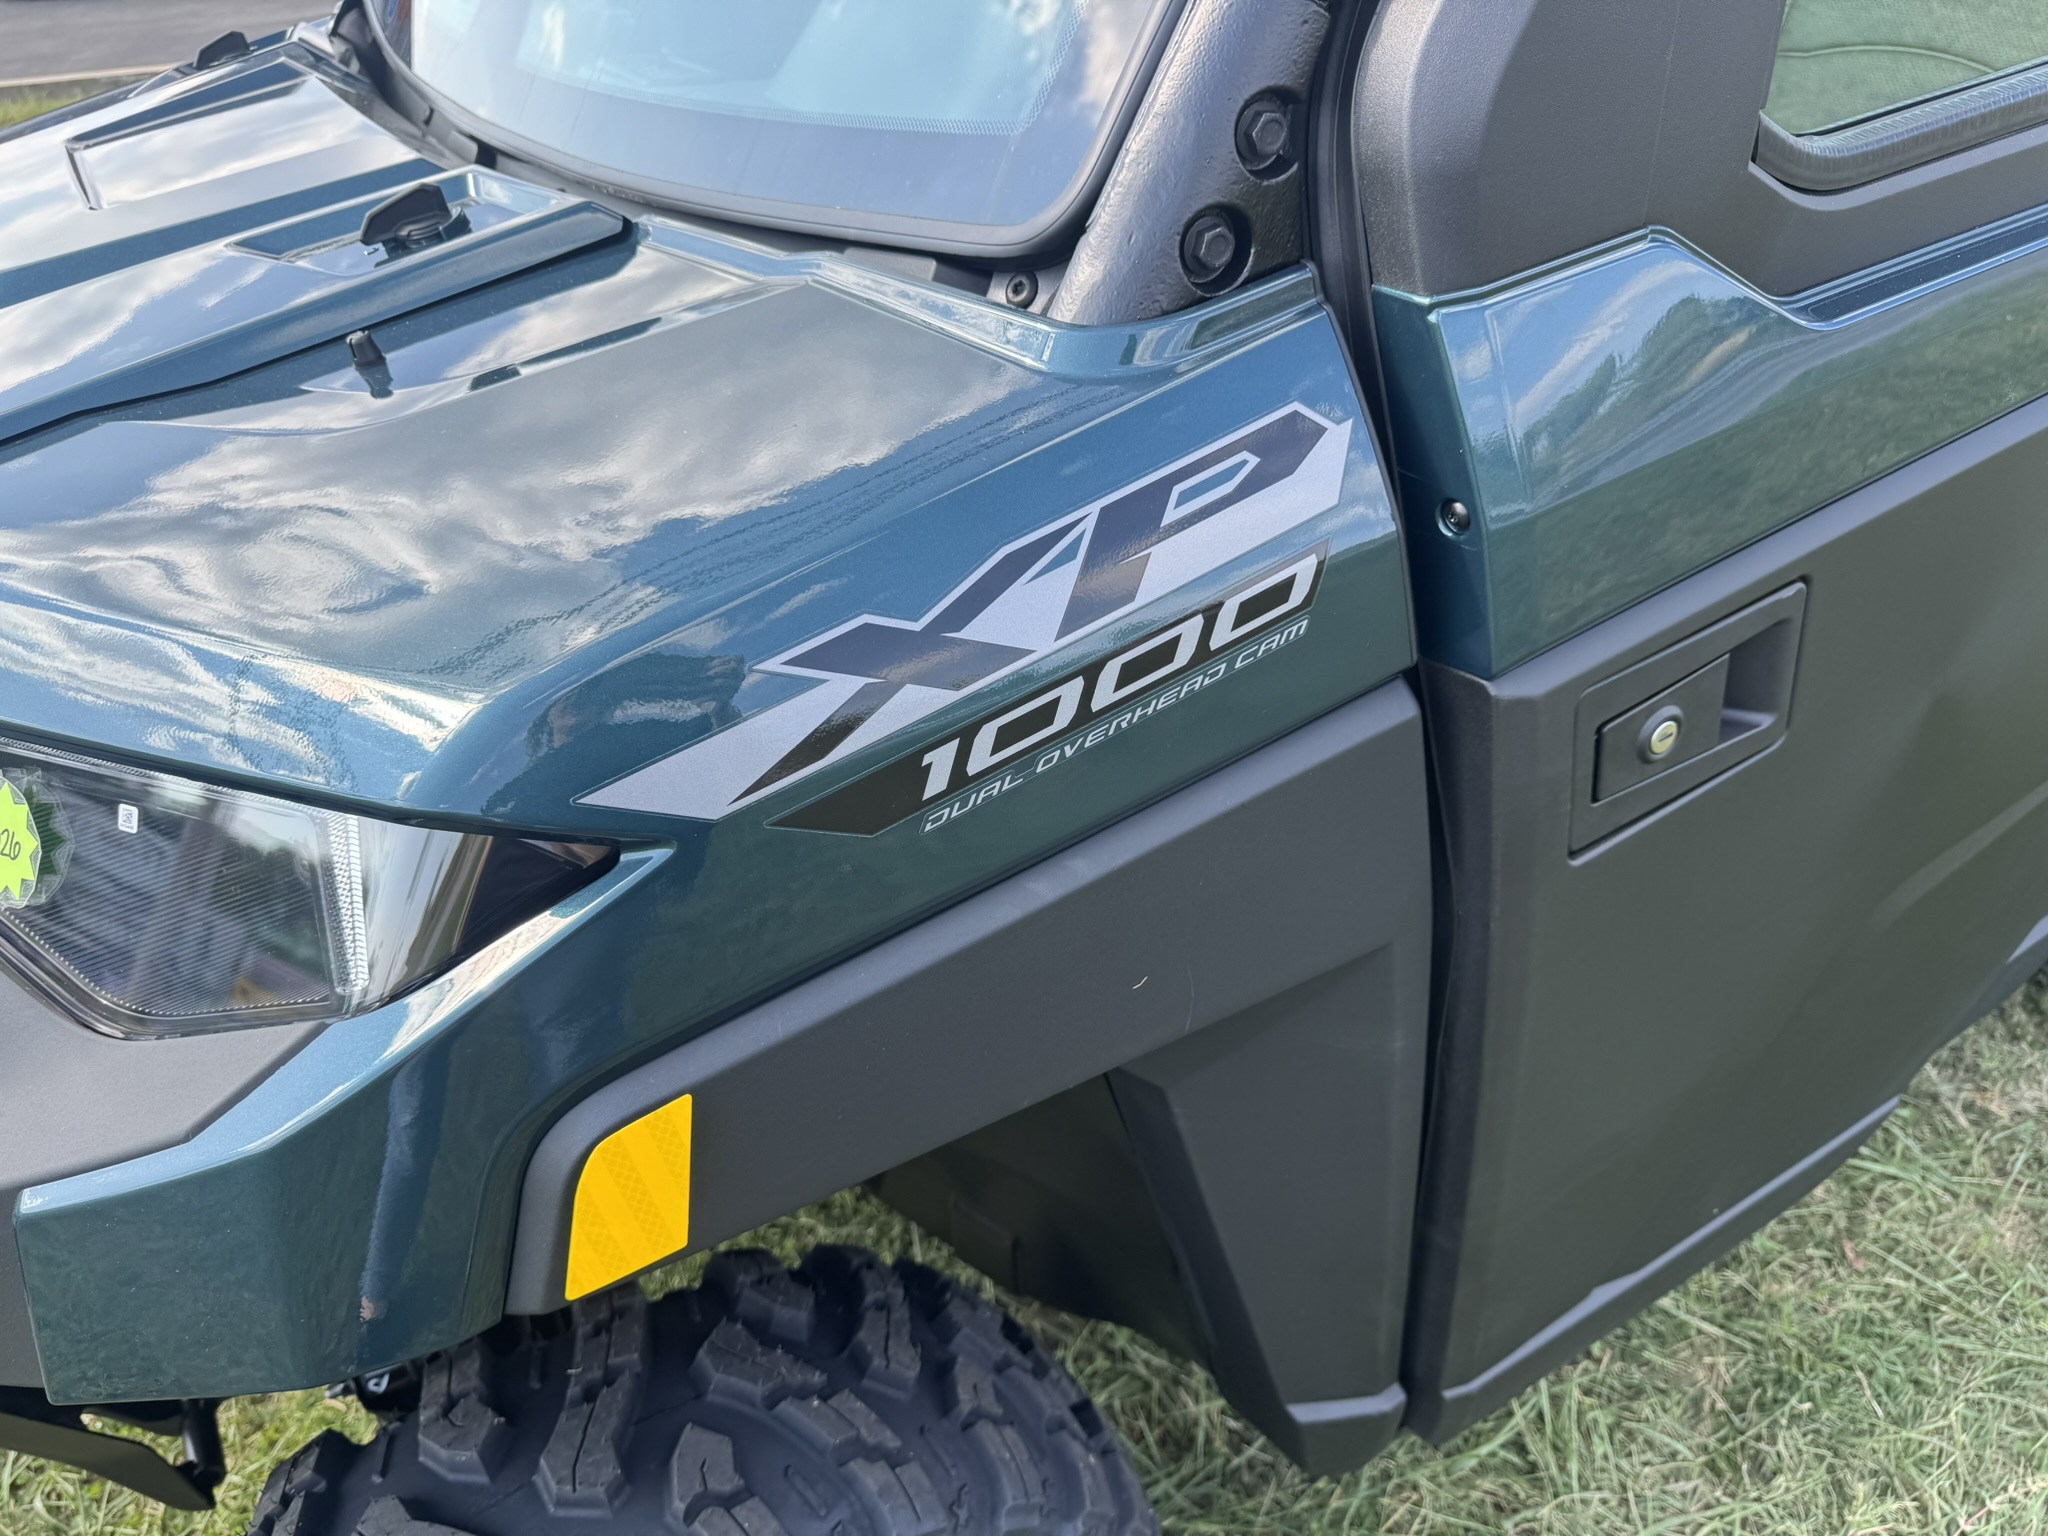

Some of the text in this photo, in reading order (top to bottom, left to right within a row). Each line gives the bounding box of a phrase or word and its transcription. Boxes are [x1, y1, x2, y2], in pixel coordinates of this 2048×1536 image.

[577, 402, 1353, 819] XP
[922, 553, 1318, 801] 1000
[923, 618, 1310, 834] DUAL OVERHEAD CAM
